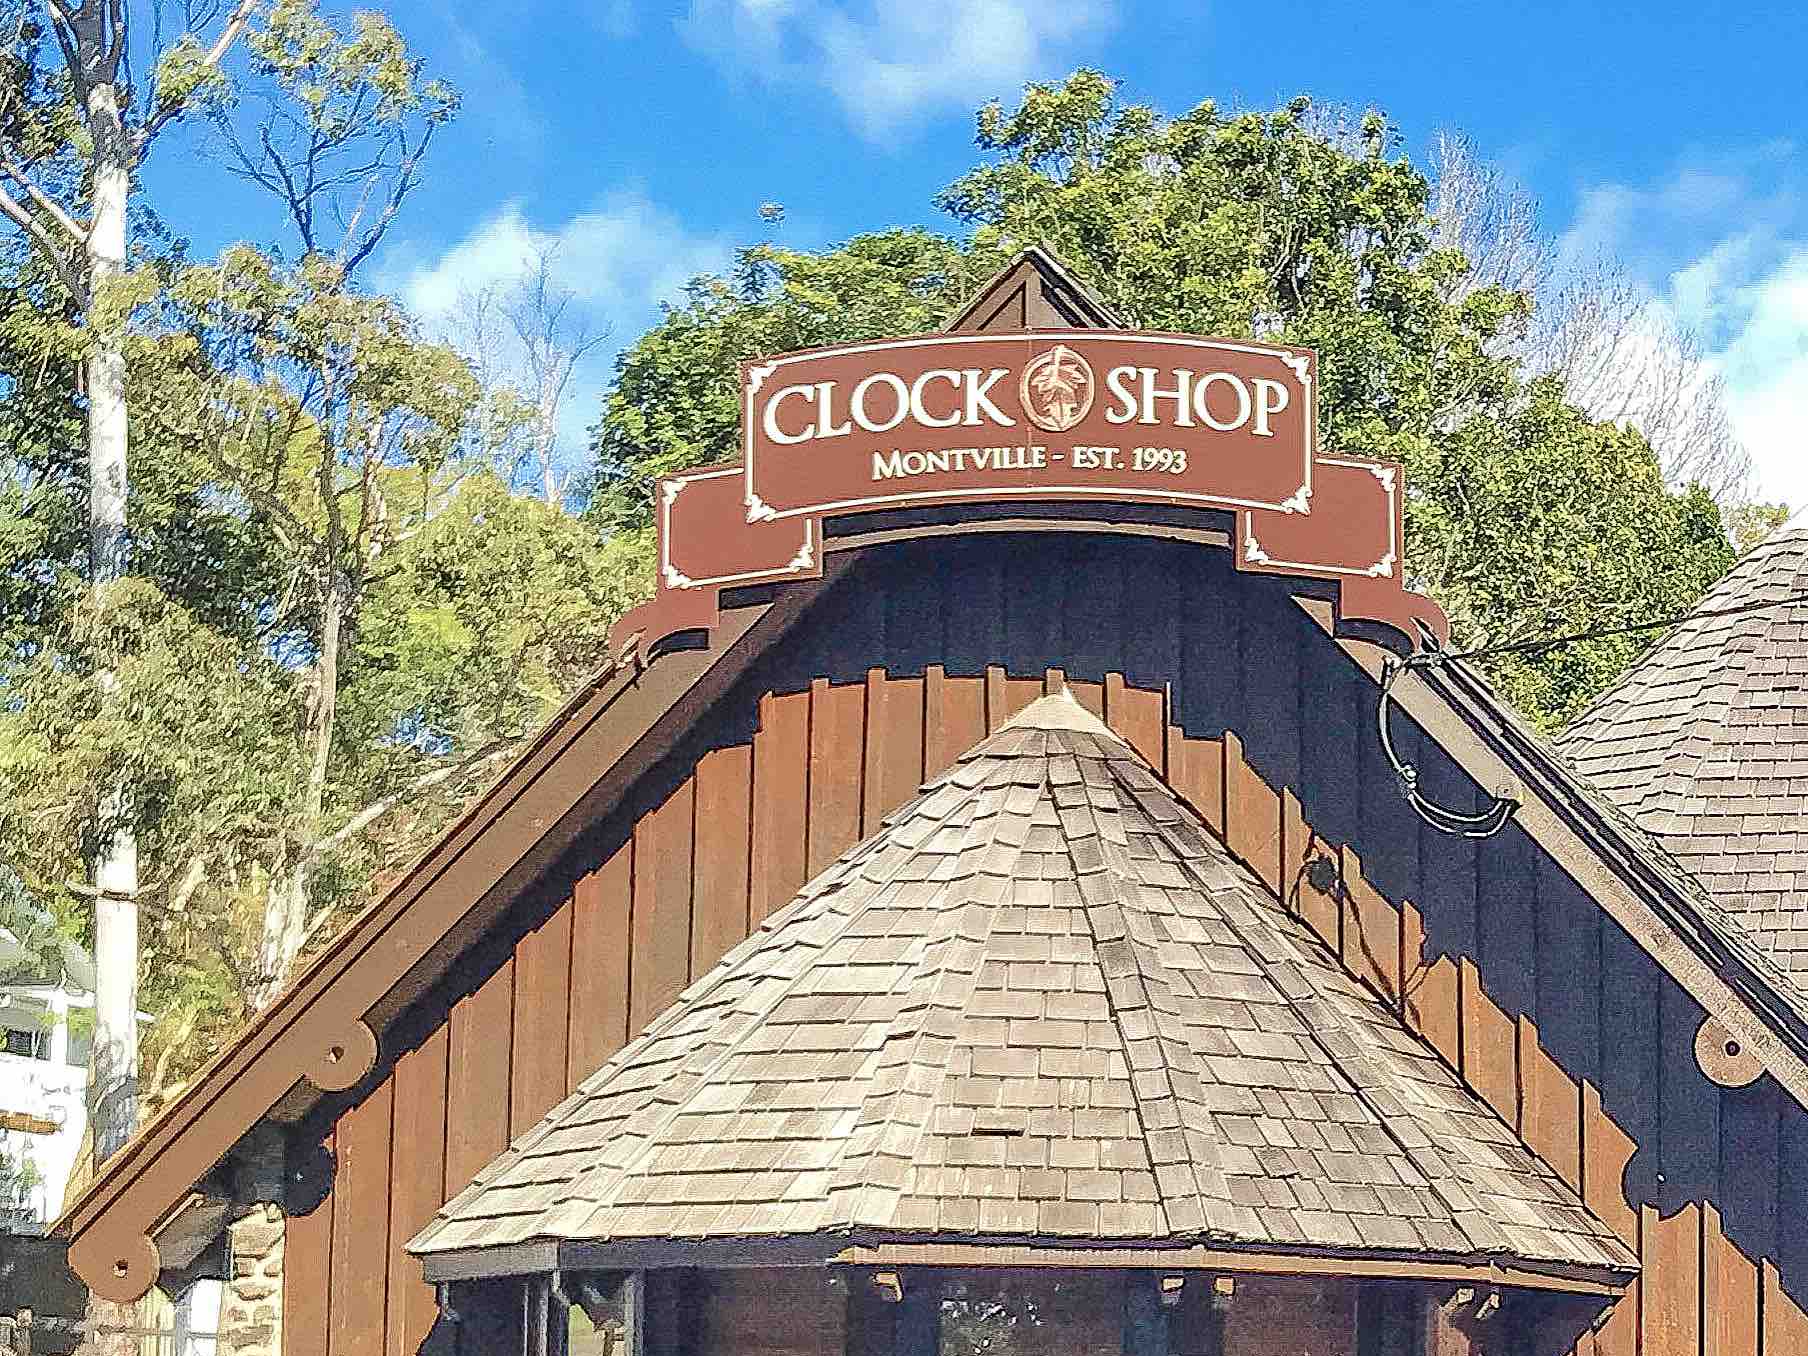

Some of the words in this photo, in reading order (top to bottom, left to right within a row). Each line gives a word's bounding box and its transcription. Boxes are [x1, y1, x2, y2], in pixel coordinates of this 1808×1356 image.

[763, 367, 1016, 446] CLOCK
[1105, 366, 1290, 438] SHOP
[1072, 446, 1125, 472] EST.
[1131, 447, 1188, 475] 1993
